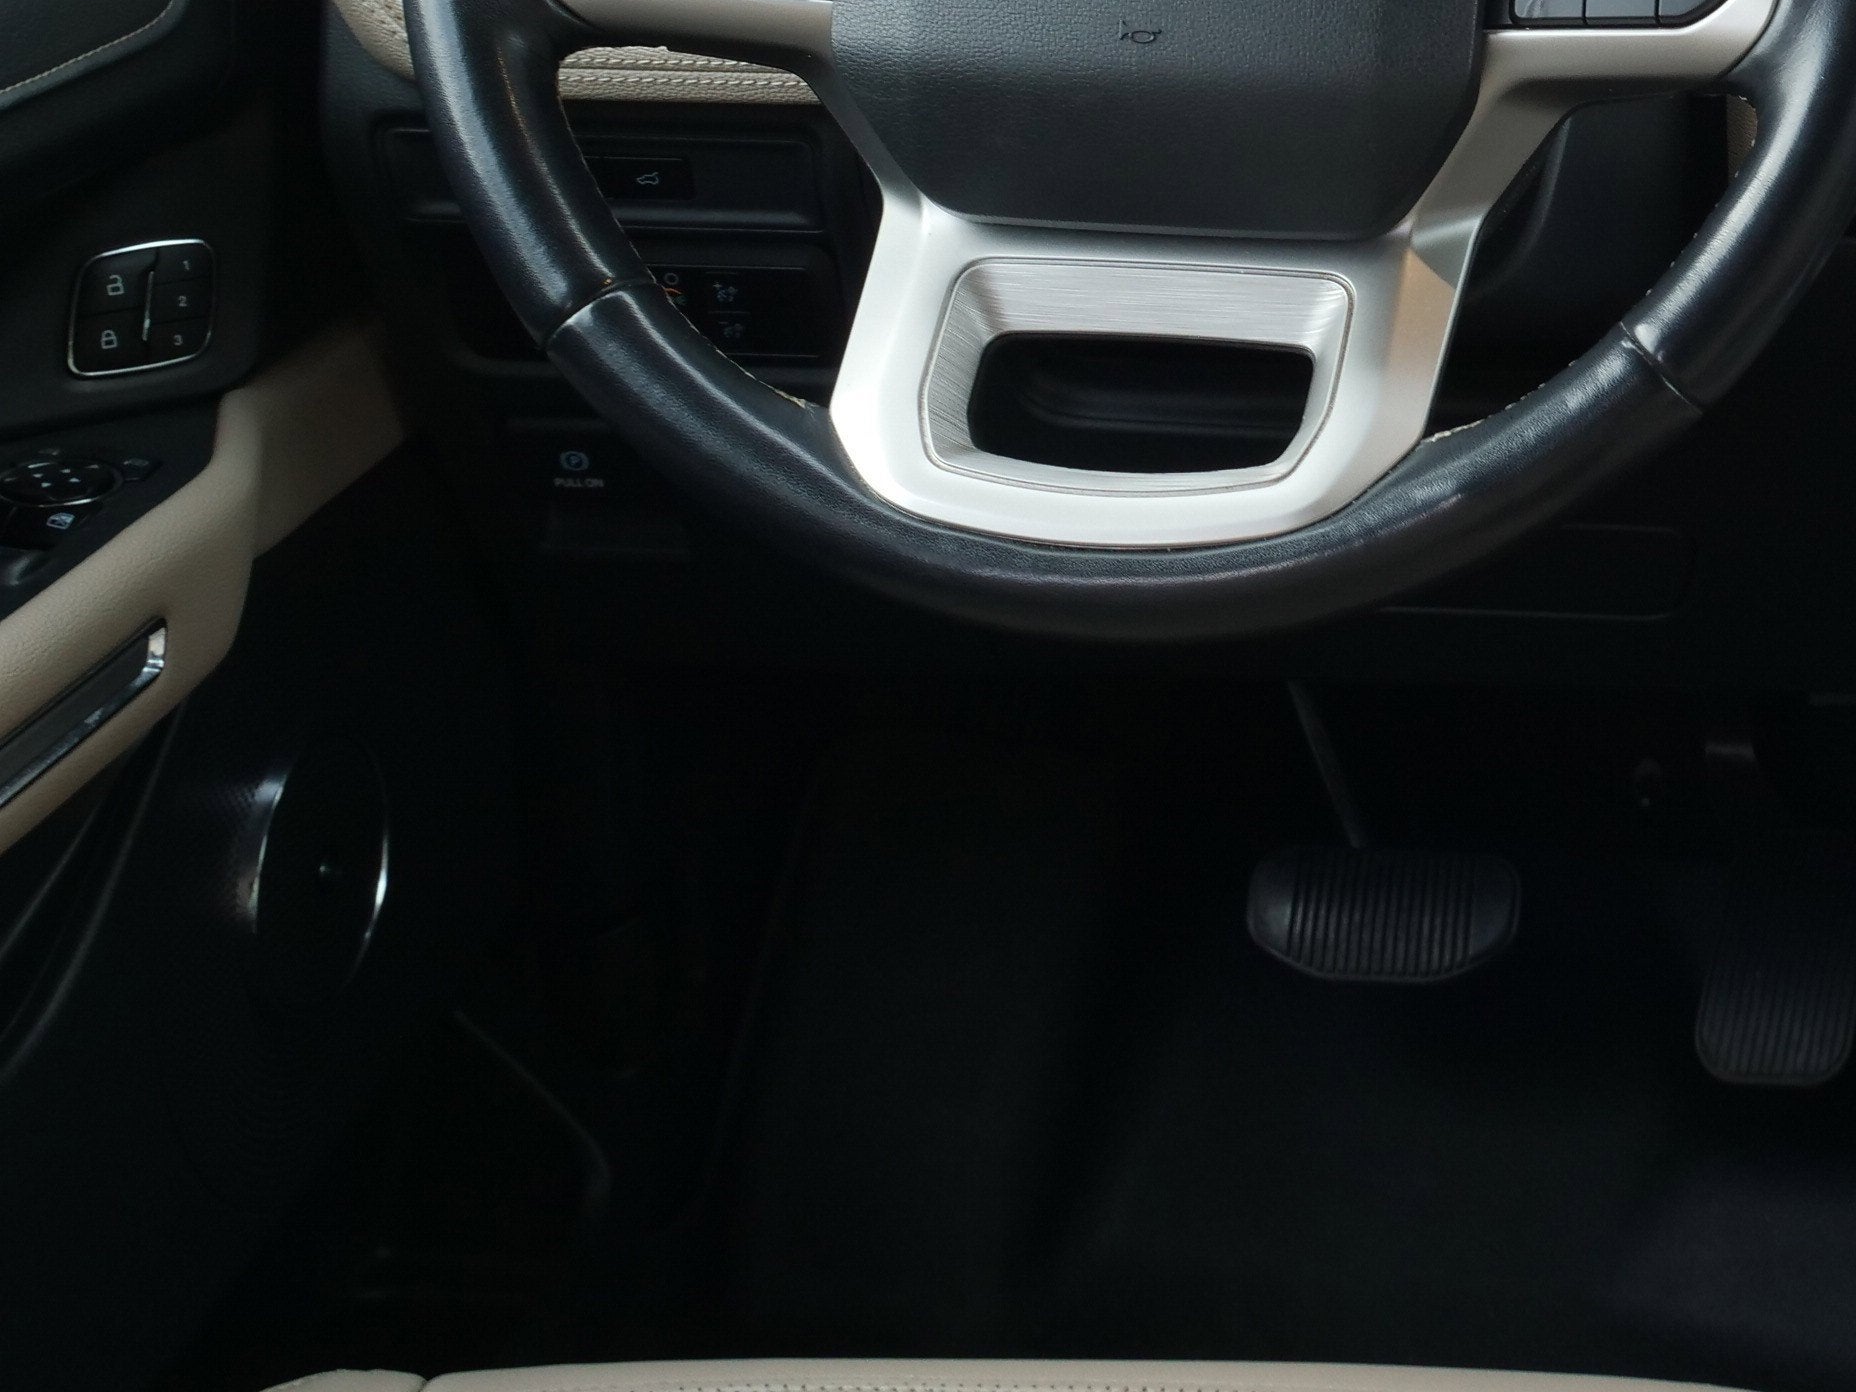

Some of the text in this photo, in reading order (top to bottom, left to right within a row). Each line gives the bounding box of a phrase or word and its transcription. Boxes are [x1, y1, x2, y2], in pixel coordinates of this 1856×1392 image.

[183, 260, 190, 271] 1
[179, 295, 188, 308] 2
[173, 334, 183, 347] 3
